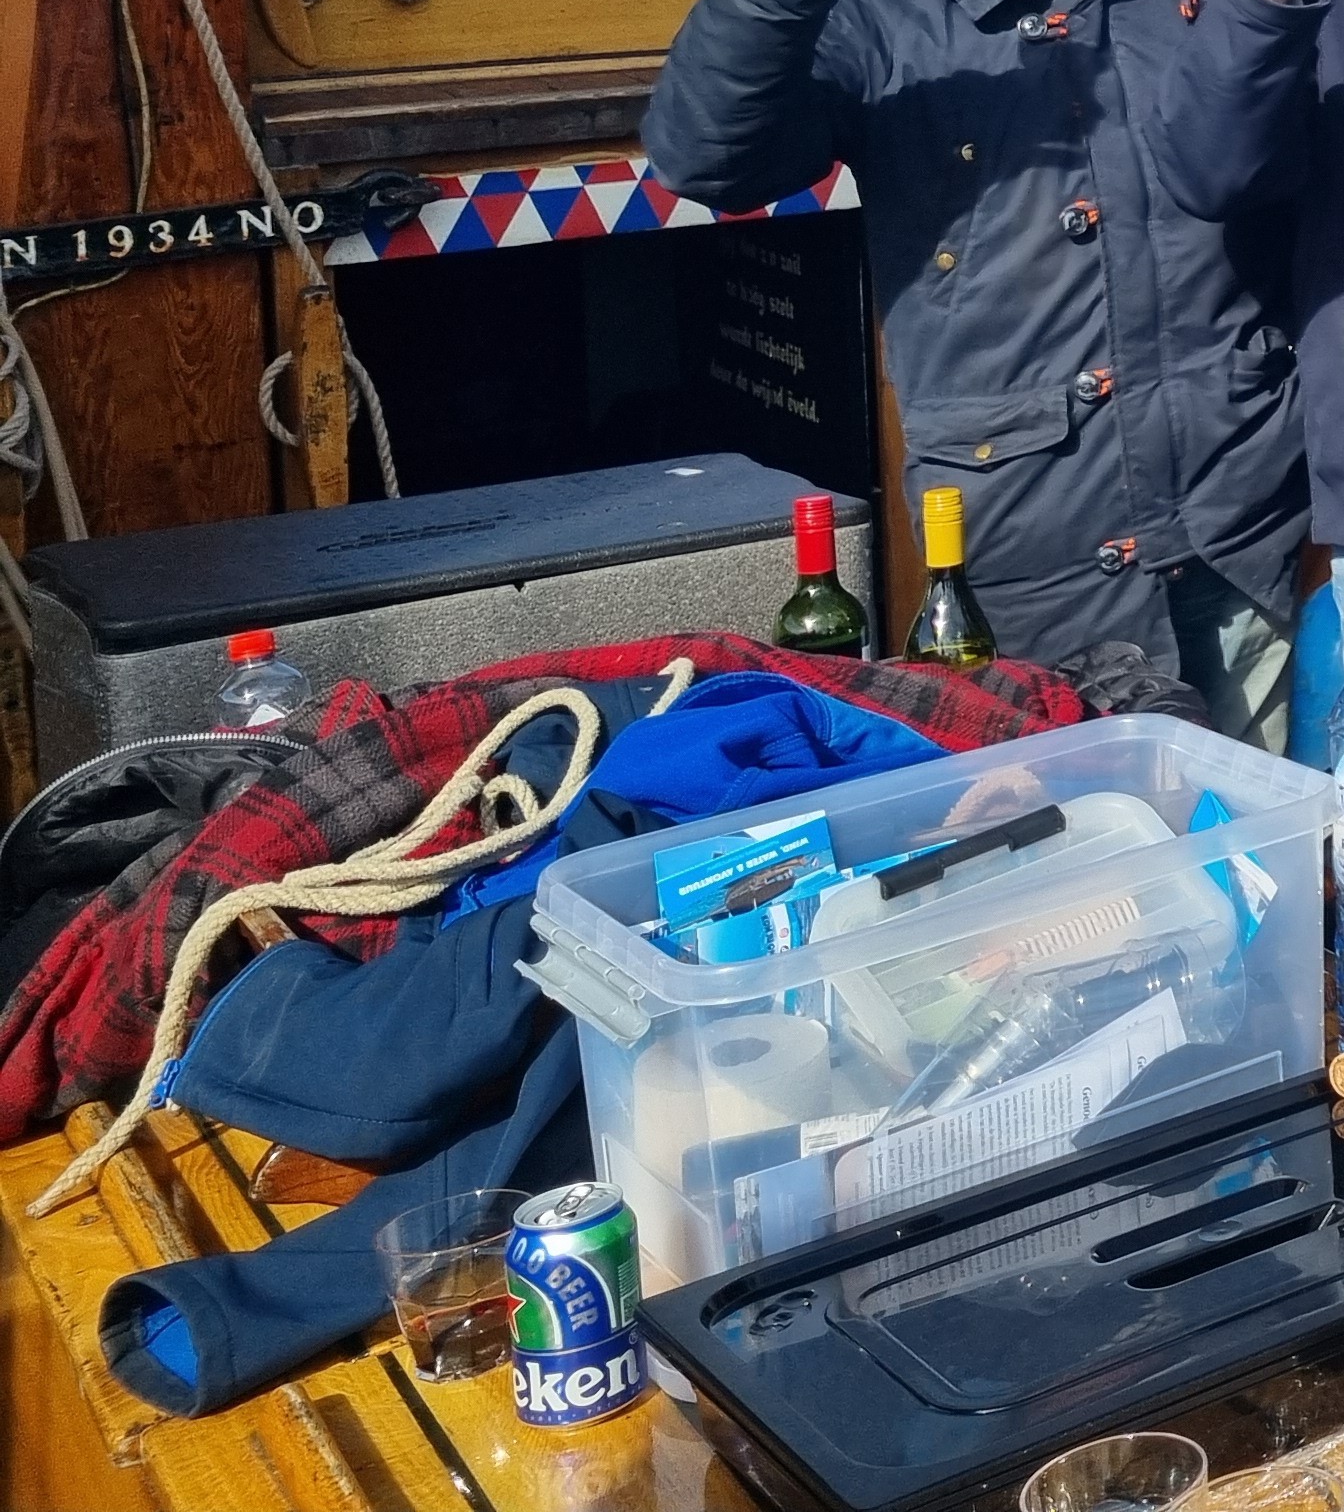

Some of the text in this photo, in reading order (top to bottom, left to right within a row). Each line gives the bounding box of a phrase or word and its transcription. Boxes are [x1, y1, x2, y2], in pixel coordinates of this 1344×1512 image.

[71, 213, 214, 263] 1934
[745, 850, 779, 870] WATER
[678, 867, 734, 897] AVONTUUR
[512, 1236, 599, 1333] 0.0 BEER
